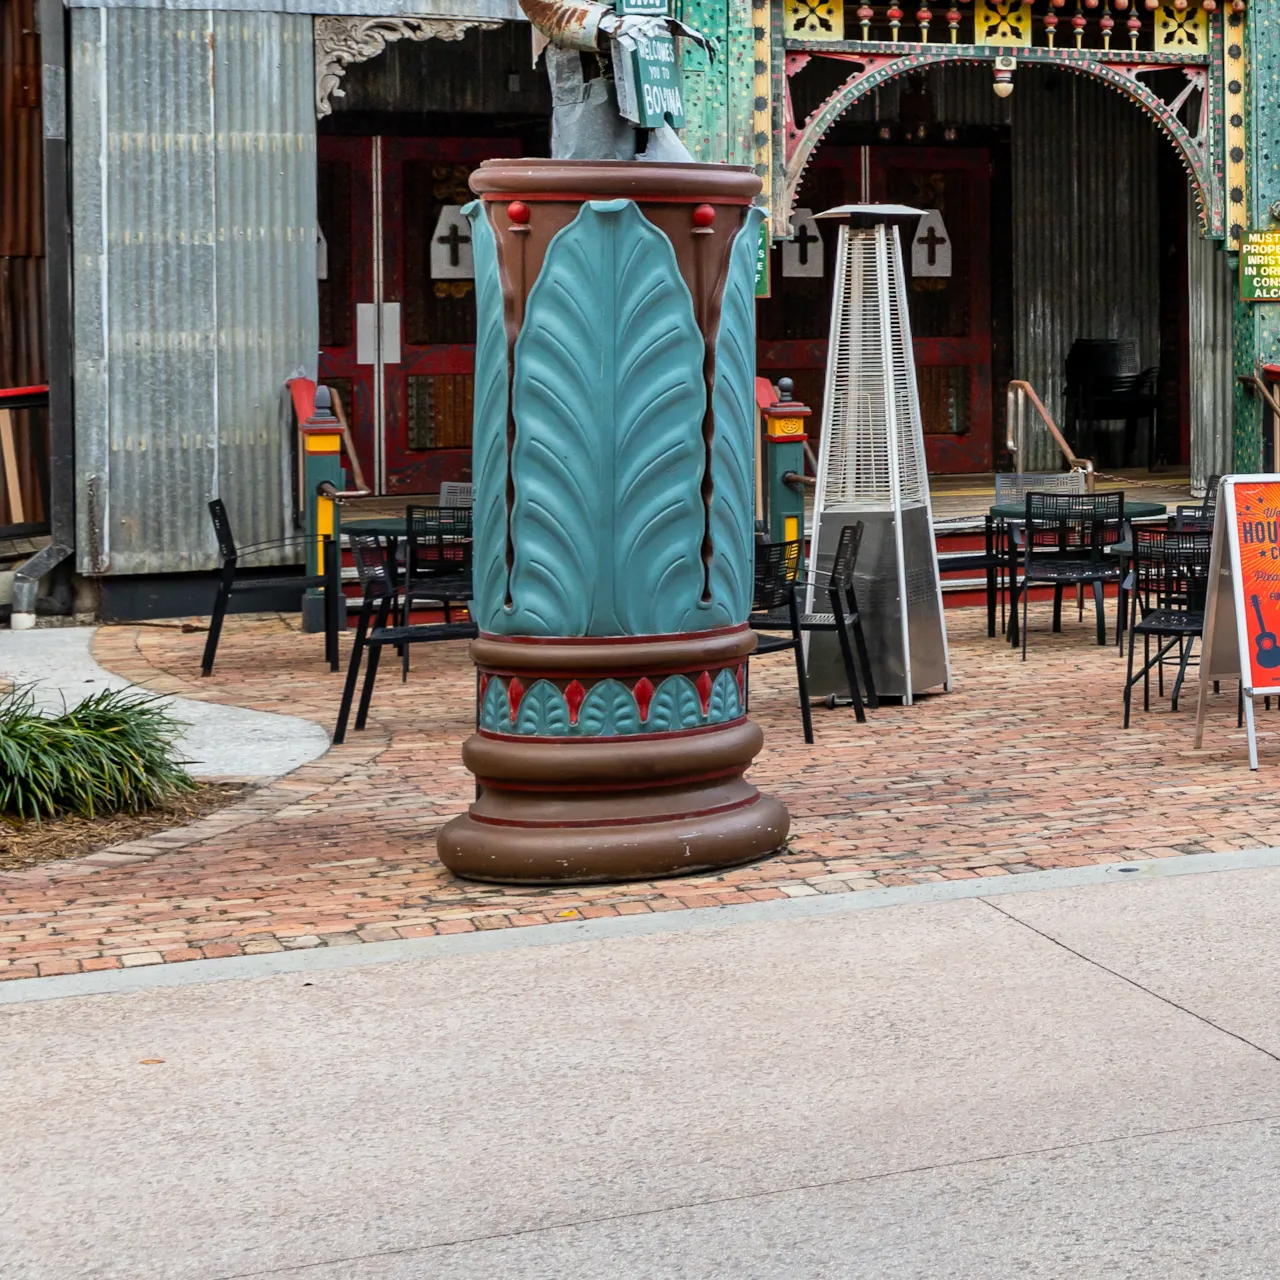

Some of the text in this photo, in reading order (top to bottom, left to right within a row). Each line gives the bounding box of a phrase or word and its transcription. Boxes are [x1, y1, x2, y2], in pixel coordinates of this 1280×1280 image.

[637, 38, 675, 63] WELCOMES
[649, 66, 670, 80] YOU TO
[644, 84, 683, 117] BOVINA
[1248, 233, 1280, 243] MUST
[1245, 266, 1257, 276] IN
